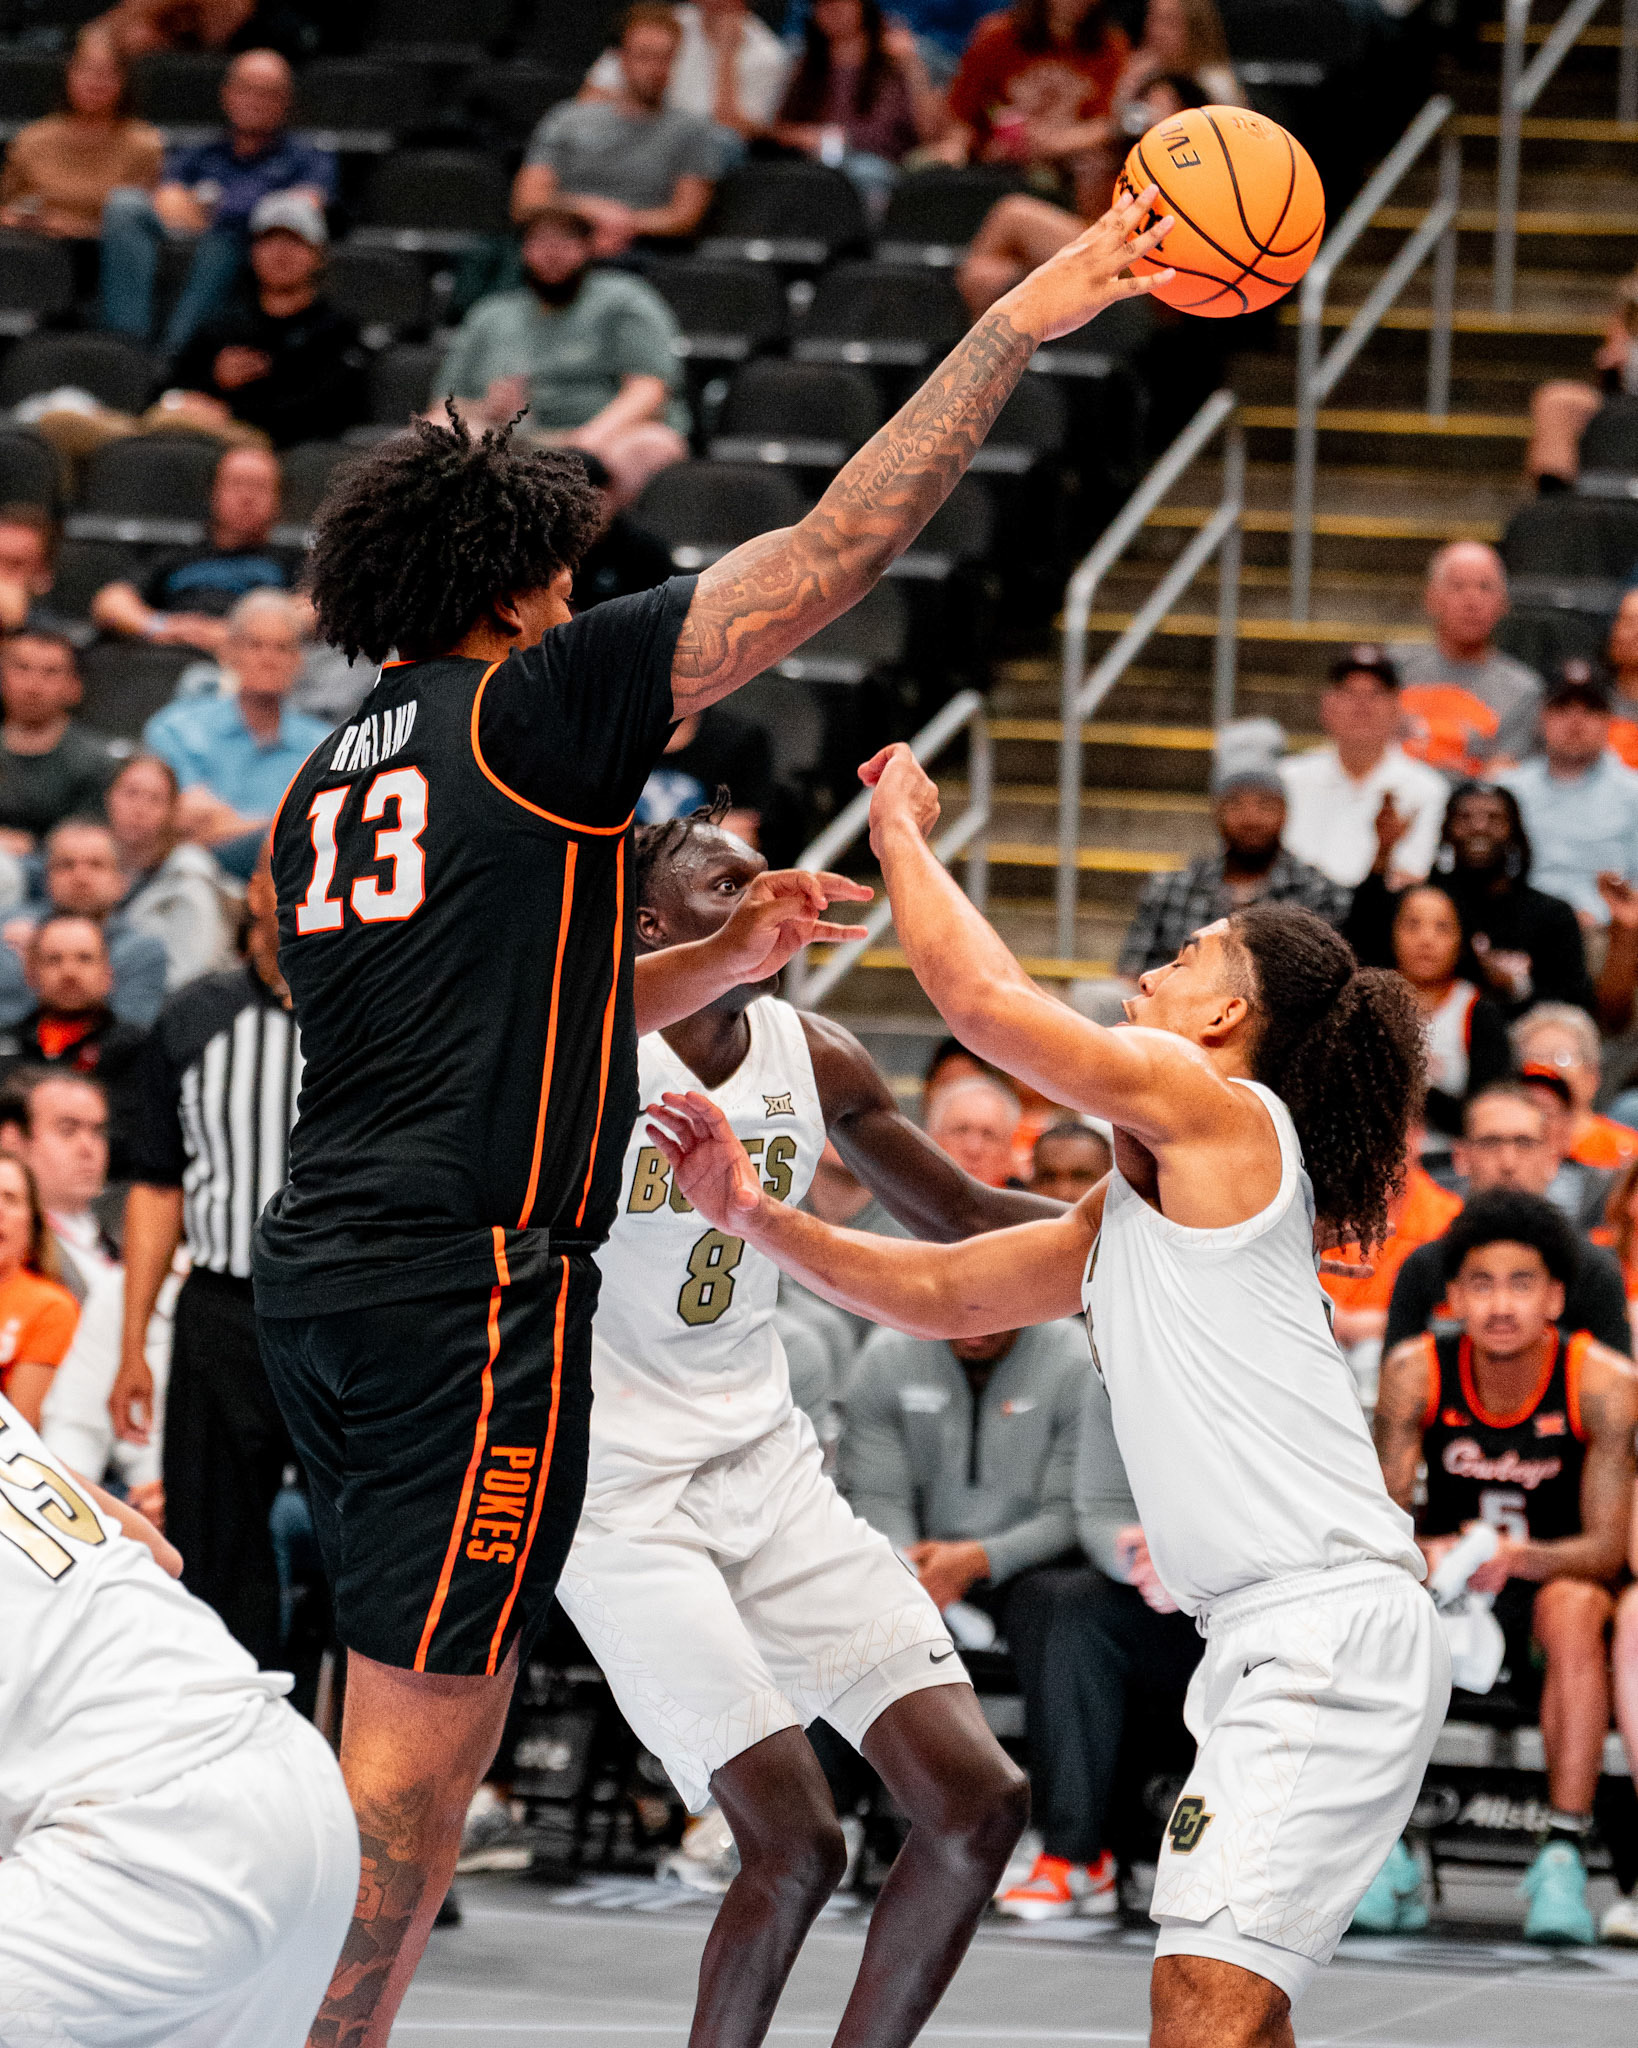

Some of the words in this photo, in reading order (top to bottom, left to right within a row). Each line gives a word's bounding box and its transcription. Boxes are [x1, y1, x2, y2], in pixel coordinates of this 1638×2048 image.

[330, 700, 417, 771] RAGLAND
[295, 765, 429, 936] 13
[677, 1228, 746, 1327] 8
[465, 1446, 537, 1564] POKES
[1168, 1795, 1216, 1856] CU
